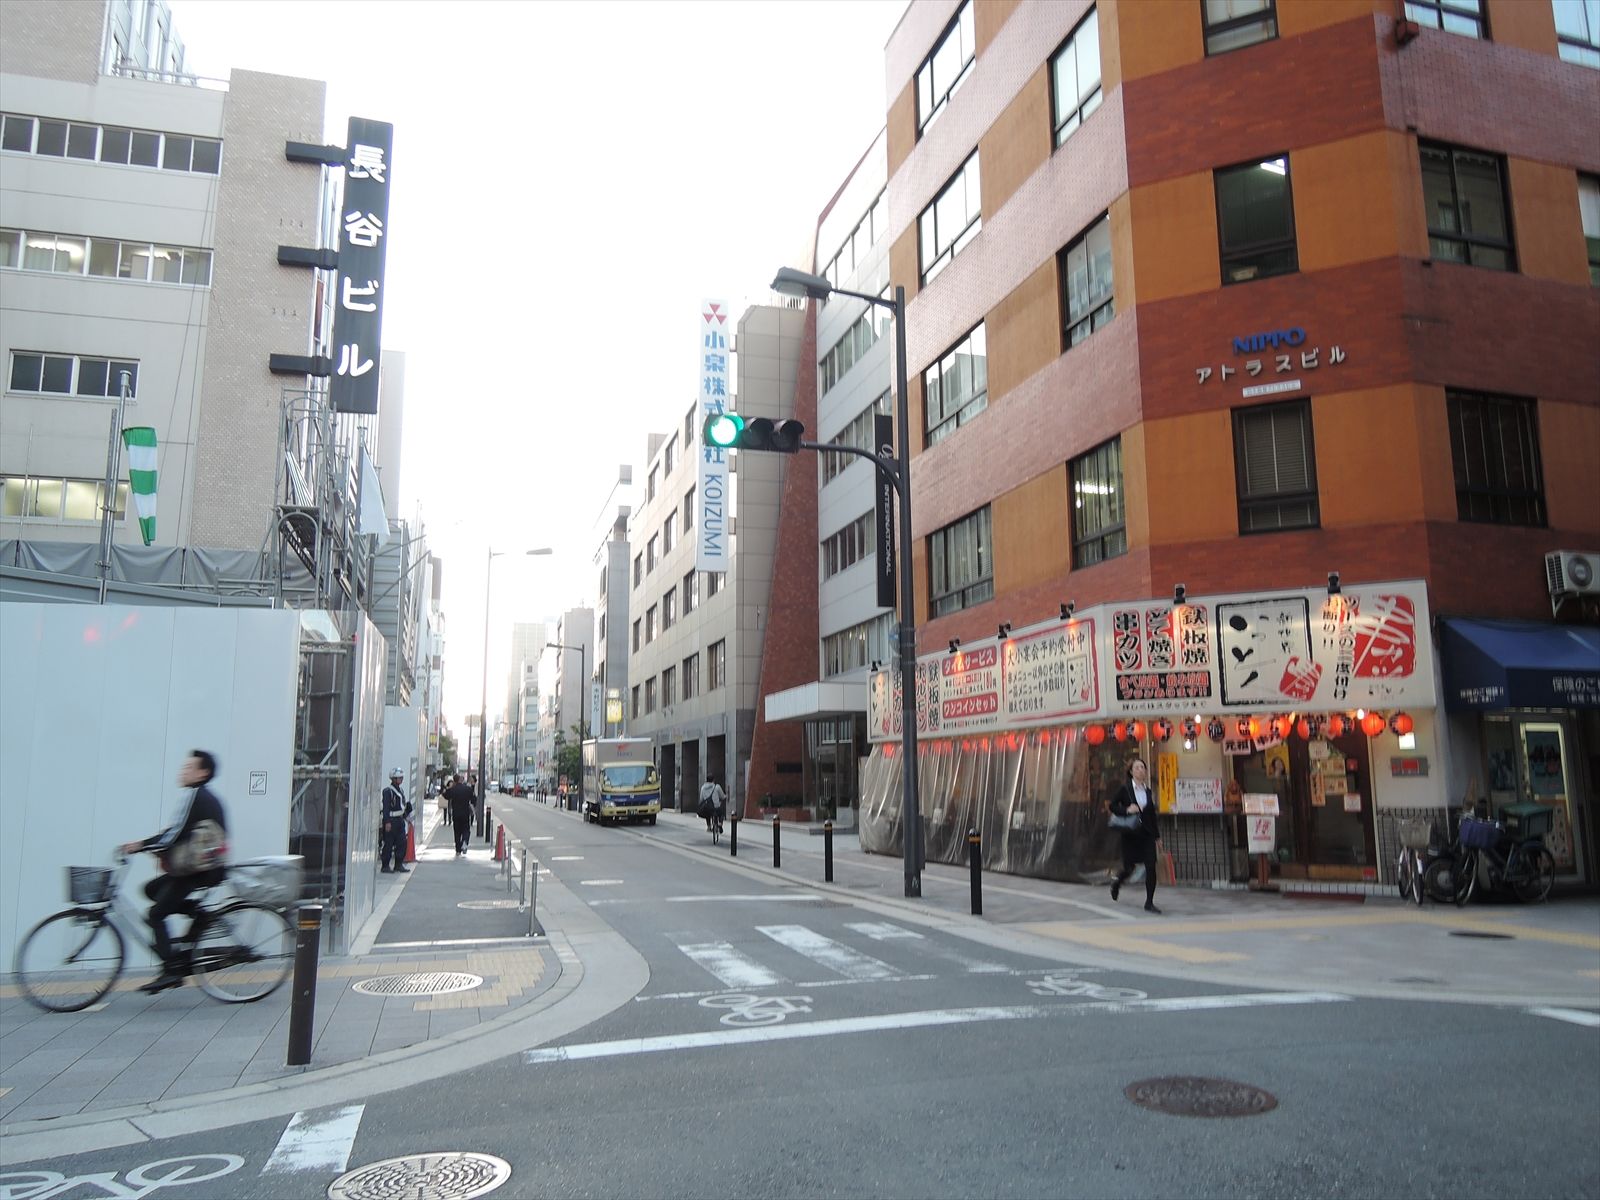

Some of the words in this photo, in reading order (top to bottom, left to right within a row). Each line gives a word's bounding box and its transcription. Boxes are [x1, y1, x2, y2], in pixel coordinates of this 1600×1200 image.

[337, 144, 387, 377] 長谷ビル
[1196, 345, 1345, 384] アトラスビル
[1232, 327, 1306, 354] NIPPO
[704, 331, 726, 465] 小泉株式社
[703, 474, 724, 557] KOIZUMI
[884, 484, 892, 577] INTERNATIONAL
[944, 649, 994, 675] タイムサービス
[1008, 631, 1085, 666] 大小宴会予約受付中
[1116, 613, 1139, 668] 串カツ
[1183, 608, 1208, 664] 鉄板焼
[929, 662, 940, 729] 鉄板焼
[944, 696, 996, 717] ワンコインセット
